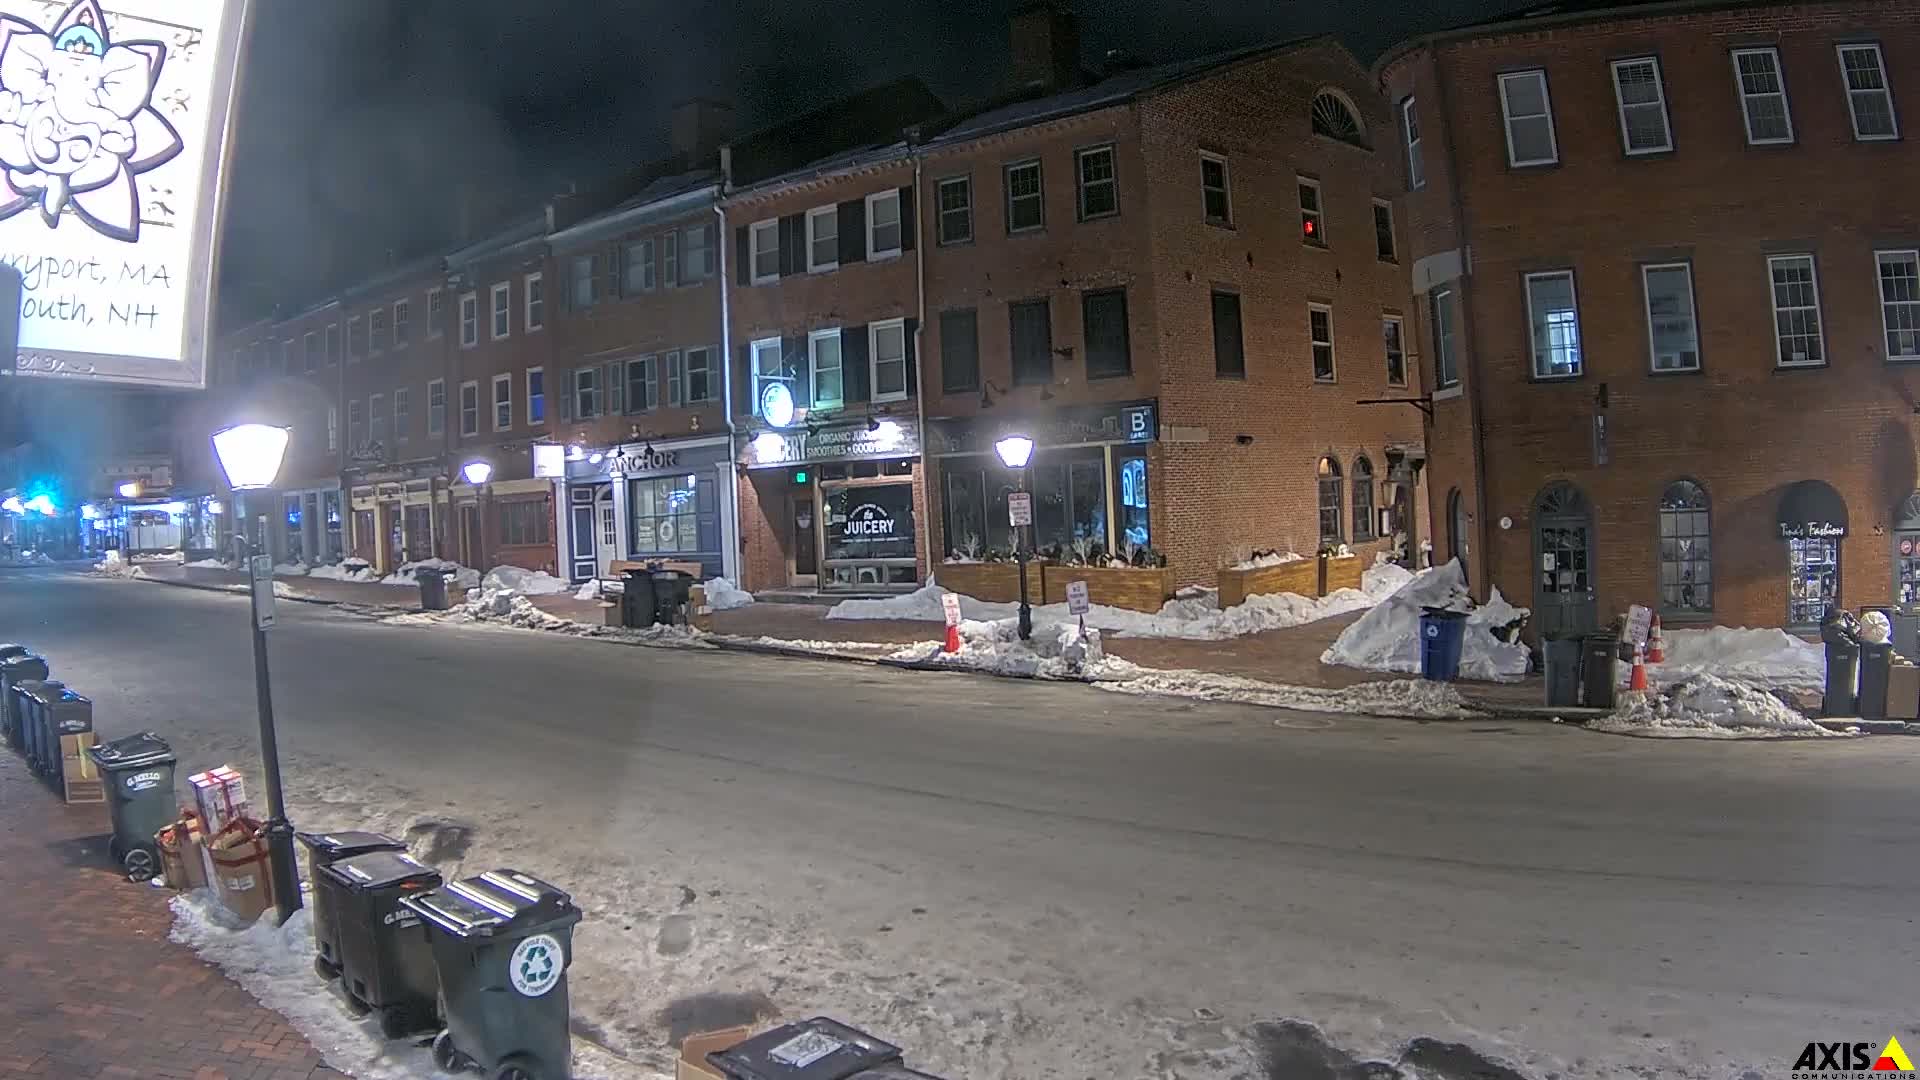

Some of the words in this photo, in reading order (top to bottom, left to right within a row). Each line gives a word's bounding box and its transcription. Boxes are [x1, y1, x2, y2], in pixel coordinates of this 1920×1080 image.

[119, 260, 170, 289] MA
[108, 302, 159, 329] NH
[818, 430, 851, 444] ORGANIC
[807, 444, 847, 457] SMOOTHIES
[609, 451, 678, 474] ANCHOR
[843, 519, 895, 535] JUICERY
